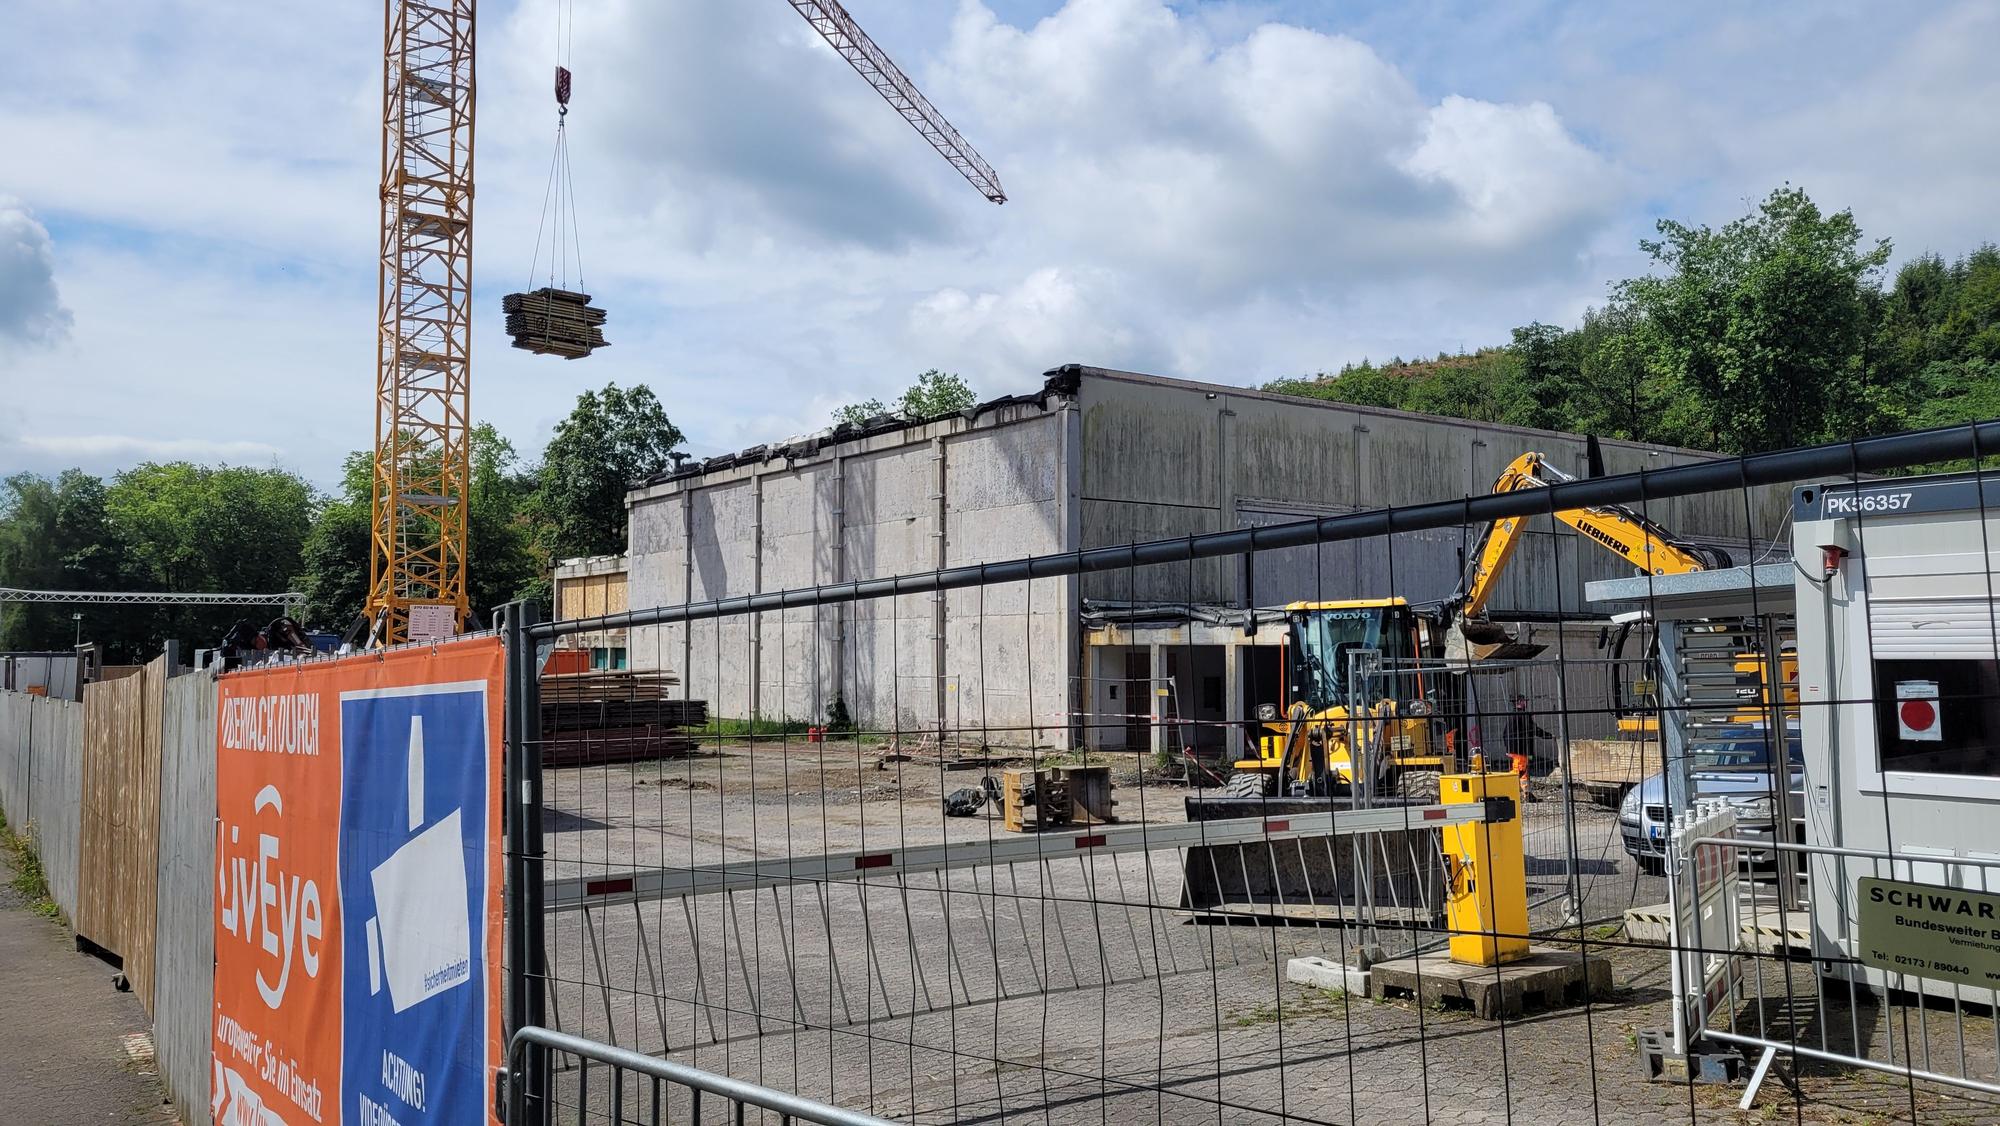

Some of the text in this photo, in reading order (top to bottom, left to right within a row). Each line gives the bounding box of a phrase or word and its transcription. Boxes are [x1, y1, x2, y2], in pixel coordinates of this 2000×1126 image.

[1827, 493, 1912, 513] PK56357
[1576, 519, 1631, 556] LIEBHERR
[1322, 612, 1371, 620] VOLVO
[278, 693, 319, 756] DURCH
[219, 821, 322, 1010] LivEye
[1870, 887, 2000, 921] SCHWAR
[1895, 915, 1987, 938] Bundesweiter
[1871, 950, 1889, 960] Tel:
[1895, 955, 1925, 968] 02173
[1933, 962, 1969, 975] 8904-0
[261, 1039, 277, 1086] Sie
[277, 1049, 289, 1097] im
[382, 1048, 426, 1113] ACHTUNG!
